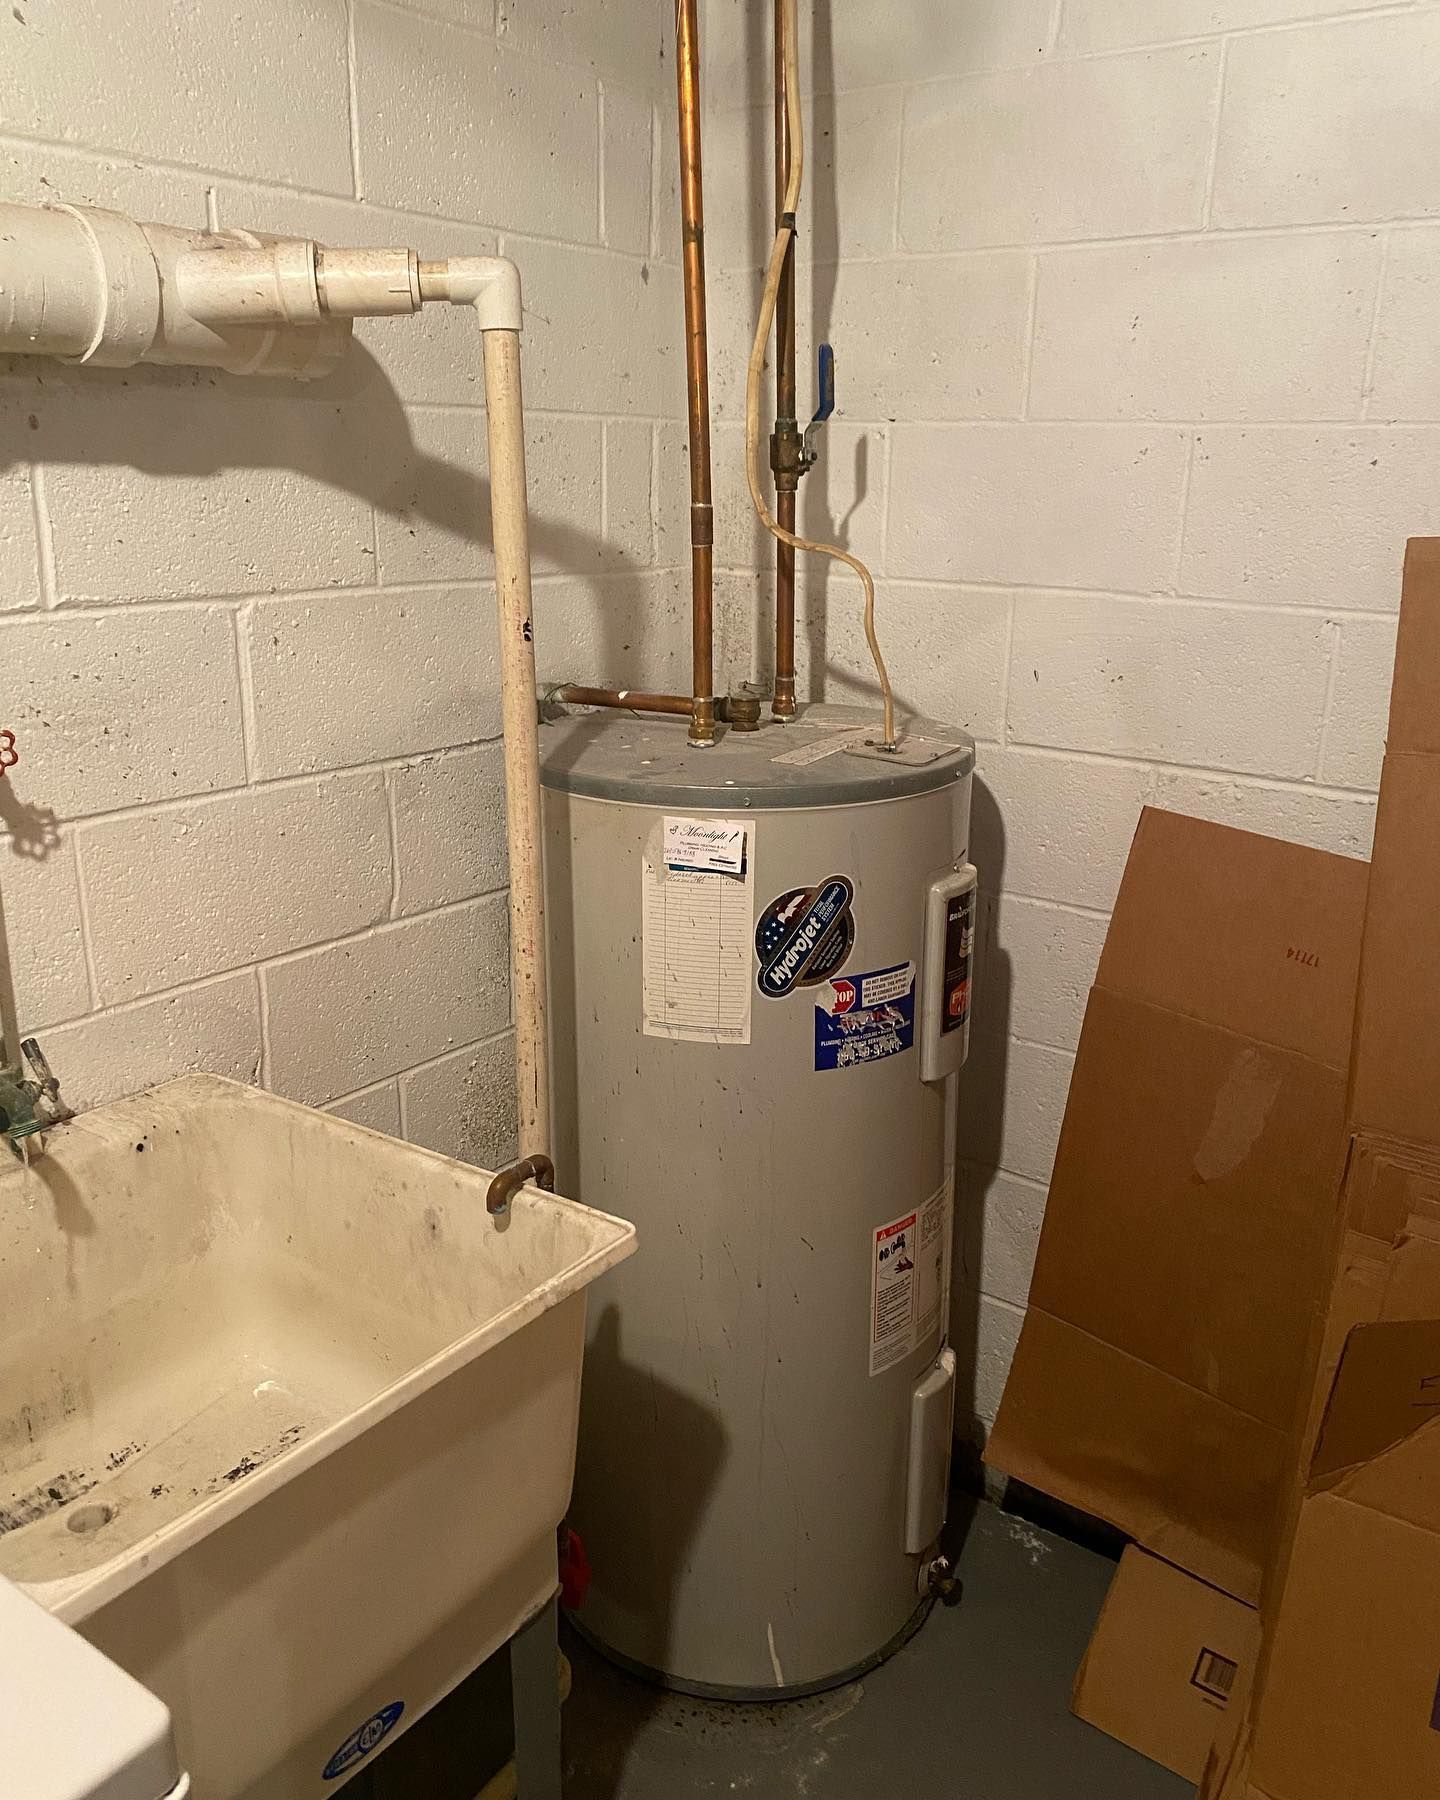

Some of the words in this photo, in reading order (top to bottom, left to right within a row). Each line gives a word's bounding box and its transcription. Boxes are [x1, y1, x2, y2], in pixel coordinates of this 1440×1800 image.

[680, 825, 728, 843] Moonlight
[814, 901, 824, 914] TOTAL
[818, 886, 840, 917] PERFORMANCE
[821, 903, 835, 921] SYSTEM
[770, 916, 821, 985] Hydrojet
[1287, 948, 1319, 967] 17114
[835, 990, 854, 1003] TOP
